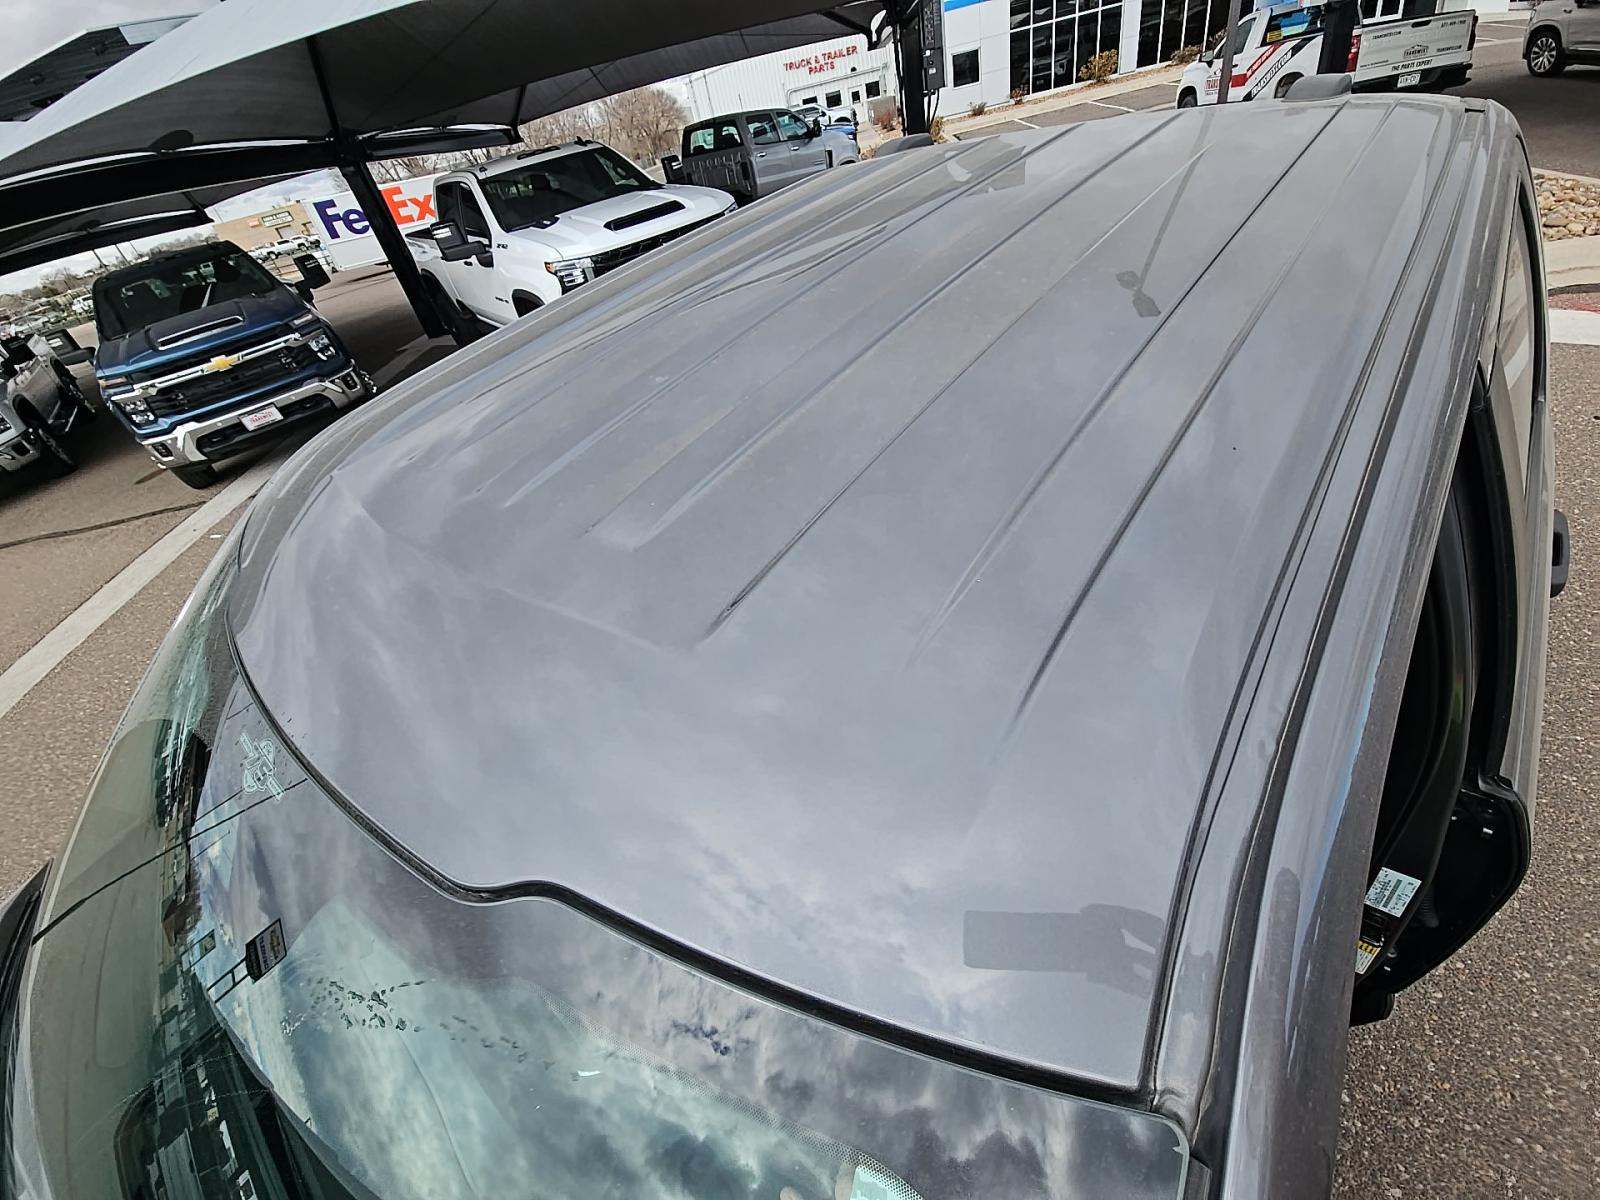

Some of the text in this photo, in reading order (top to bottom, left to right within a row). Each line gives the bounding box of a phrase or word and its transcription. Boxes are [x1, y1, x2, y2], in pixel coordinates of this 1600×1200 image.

[783, 45, 858, 71] TRUCK & TRAILER
[808, 61, 836, 75] PARTS
[313, 186, 437, 240] FeEx
